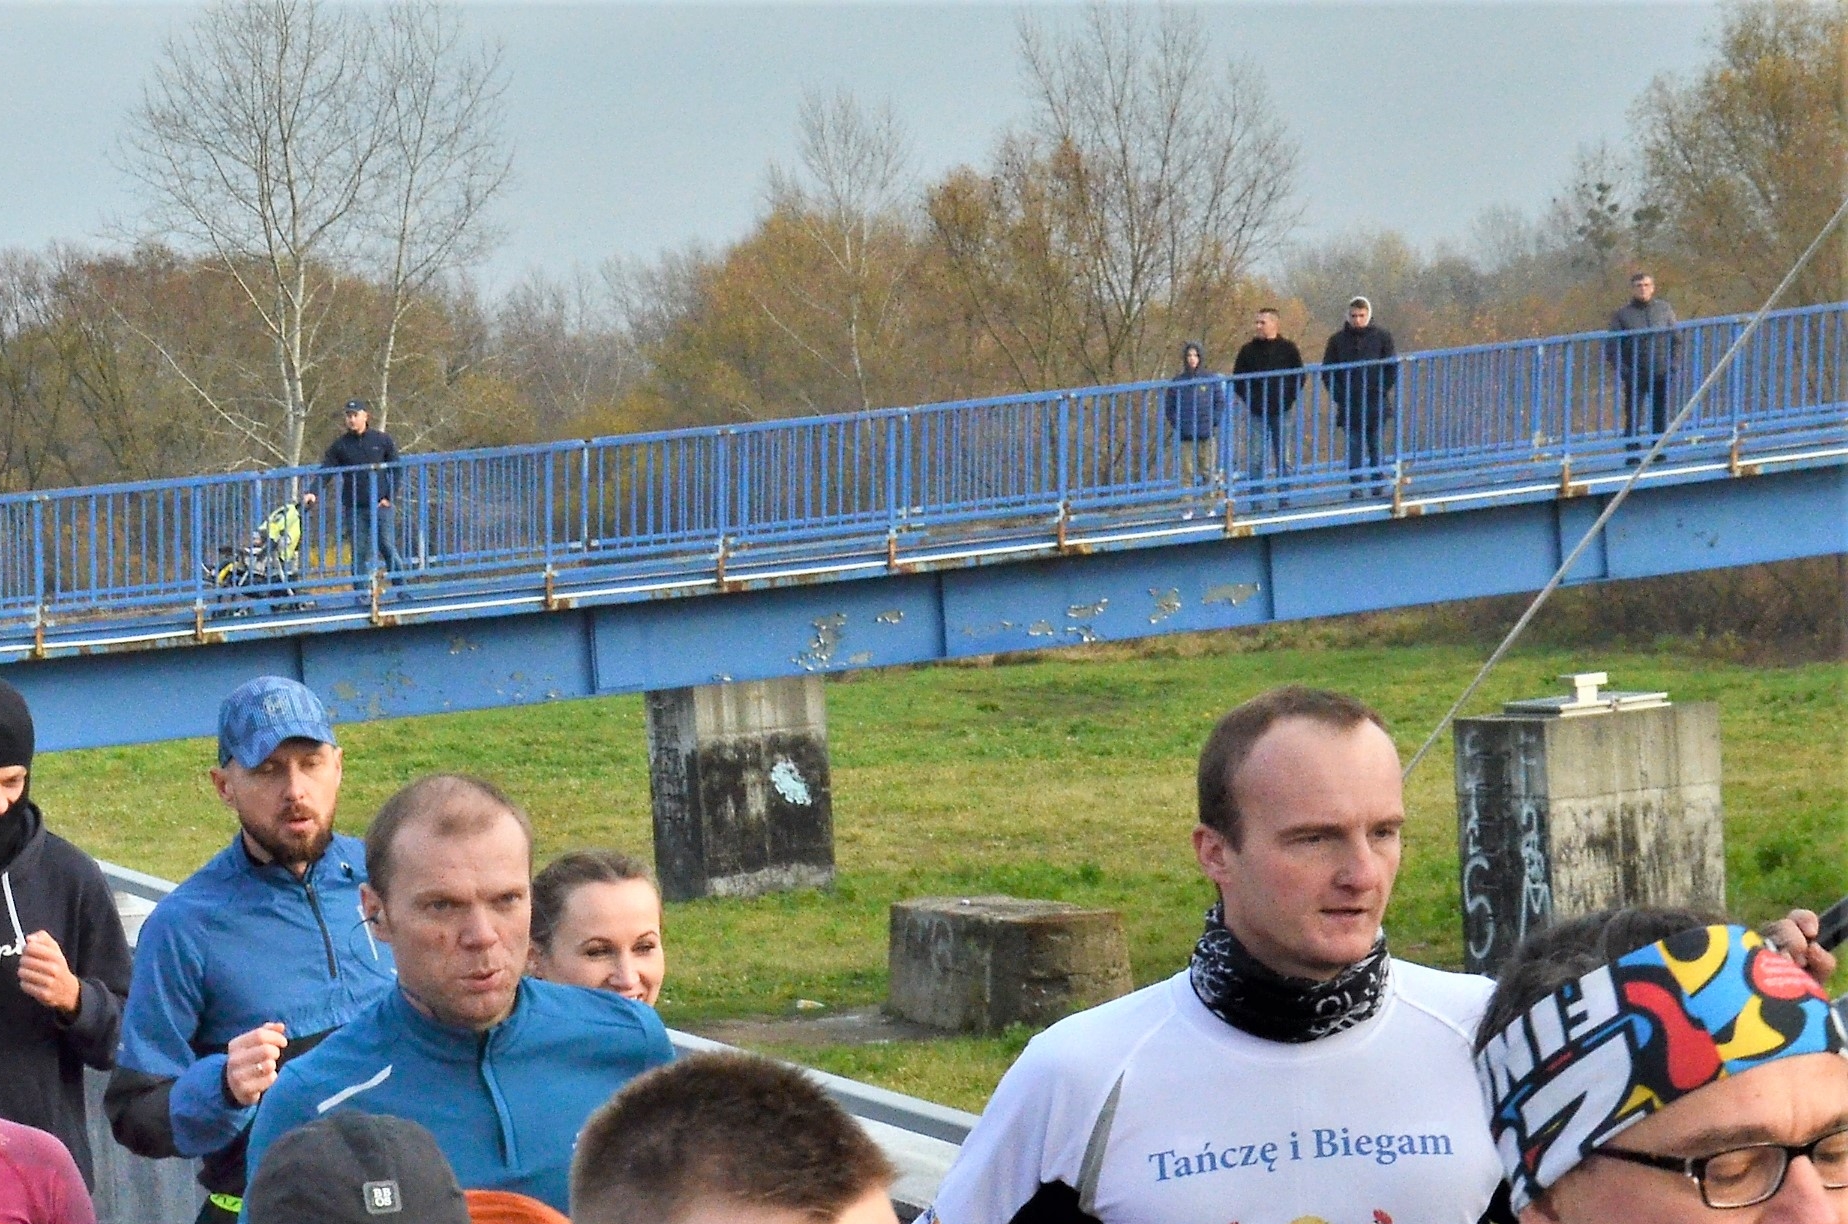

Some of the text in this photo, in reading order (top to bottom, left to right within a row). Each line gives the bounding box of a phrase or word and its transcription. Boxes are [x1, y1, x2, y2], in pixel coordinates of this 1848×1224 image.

[1149, 1127, 1454, 1181] Tańczę i Biegam
